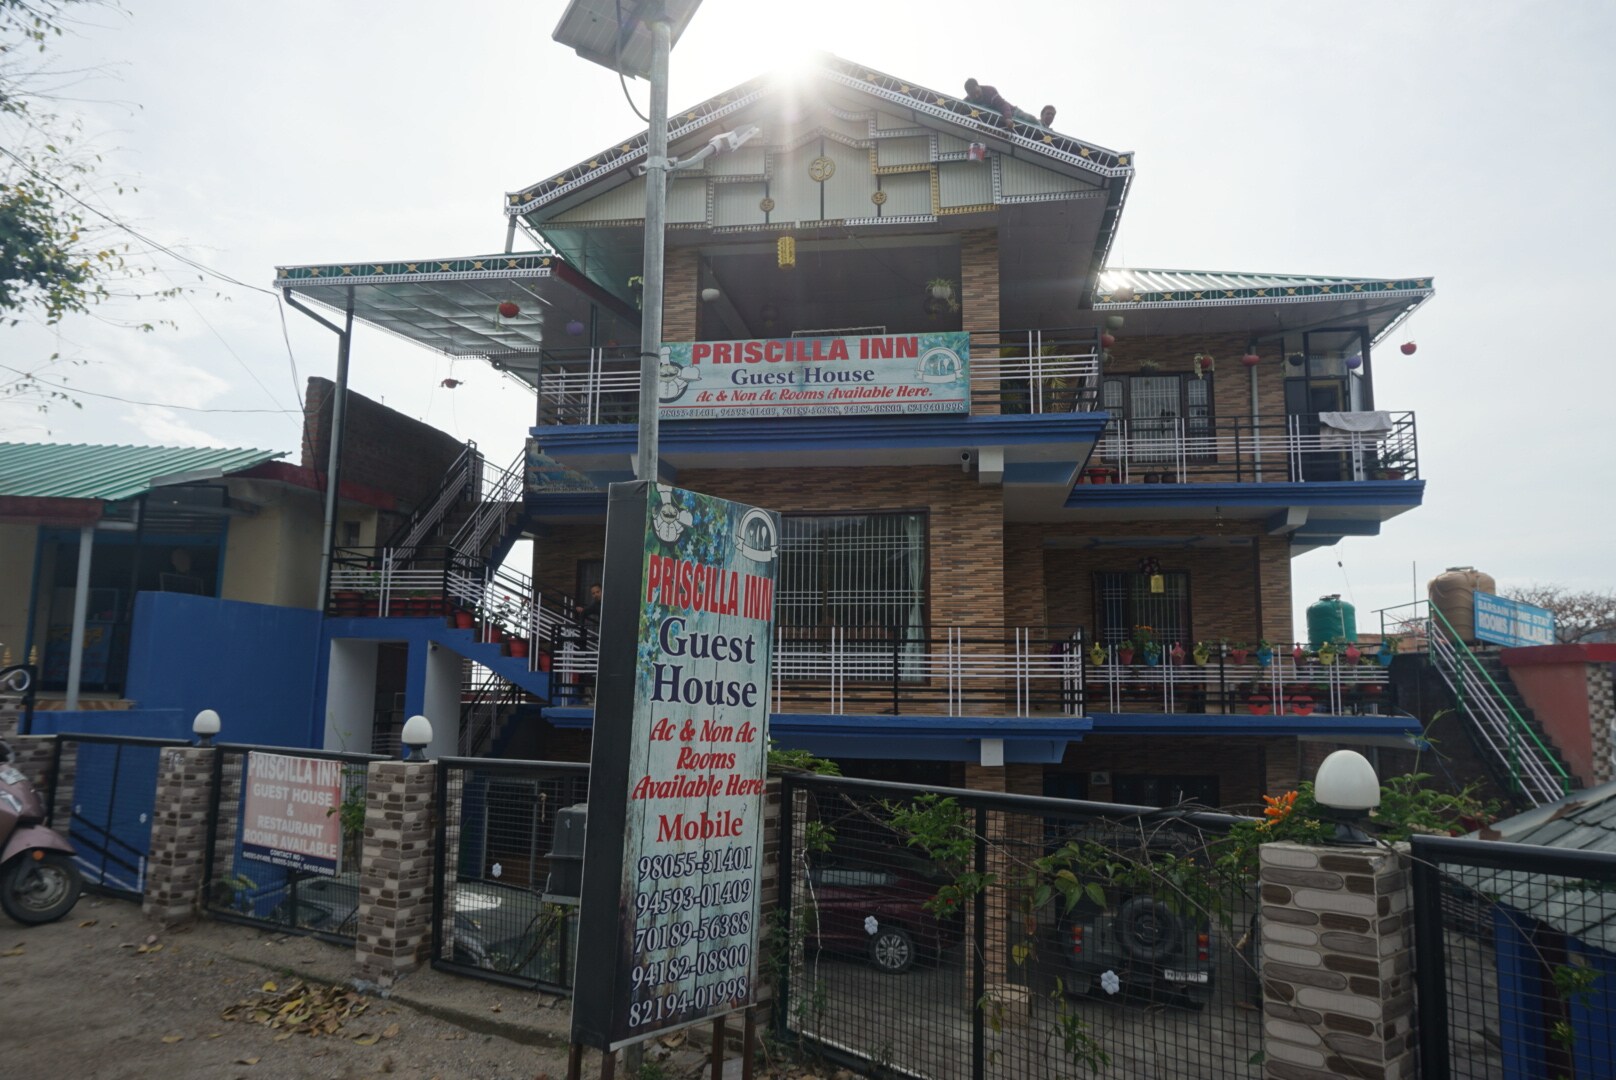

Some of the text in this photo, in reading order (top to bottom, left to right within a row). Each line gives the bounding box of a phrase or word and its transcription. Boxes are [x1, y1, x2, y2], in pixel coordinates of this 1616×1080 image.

[692, 336, 918, 365] PRISCILLA INN
[731, 366, 875, 385] Guest House
[696, 386, 933, 402] Ac & Non Ac Rooms Available Here.
[647, 554, 774, 622] PRISCILLA INN
[1478, 611, 1508, 635] ROOMS
[659, 616, 756, 664] Guest
[650, 662, 757, 708] House
[650, 717, 757, 743] Ac & Non Ac
[248, 752, 341, 788] PRISCILLA INN
[676, 746, 736, 770] Rooms
[252, 783, 333, 807] GUEST HOUSE
[631, 774, 768, 800] Available Here.
[286, 803, 294, 817] &
[256, 815, 324, 838] RESTAURANT
[656, 809, 744, 843] Mobile
[244, 828, 337, 858] ROOMS AVAILABLE
[269, 849, 293, 859] CONTACT
[638, 845, 753, 883] 98055-31401
[636, 878, 753, 919] 94593-01409
[634, 910, 751, 955] 70189-56388
[631, 943, 749, 992] 94182-08800
[628, 975, 748, 1028] 82194-01998
